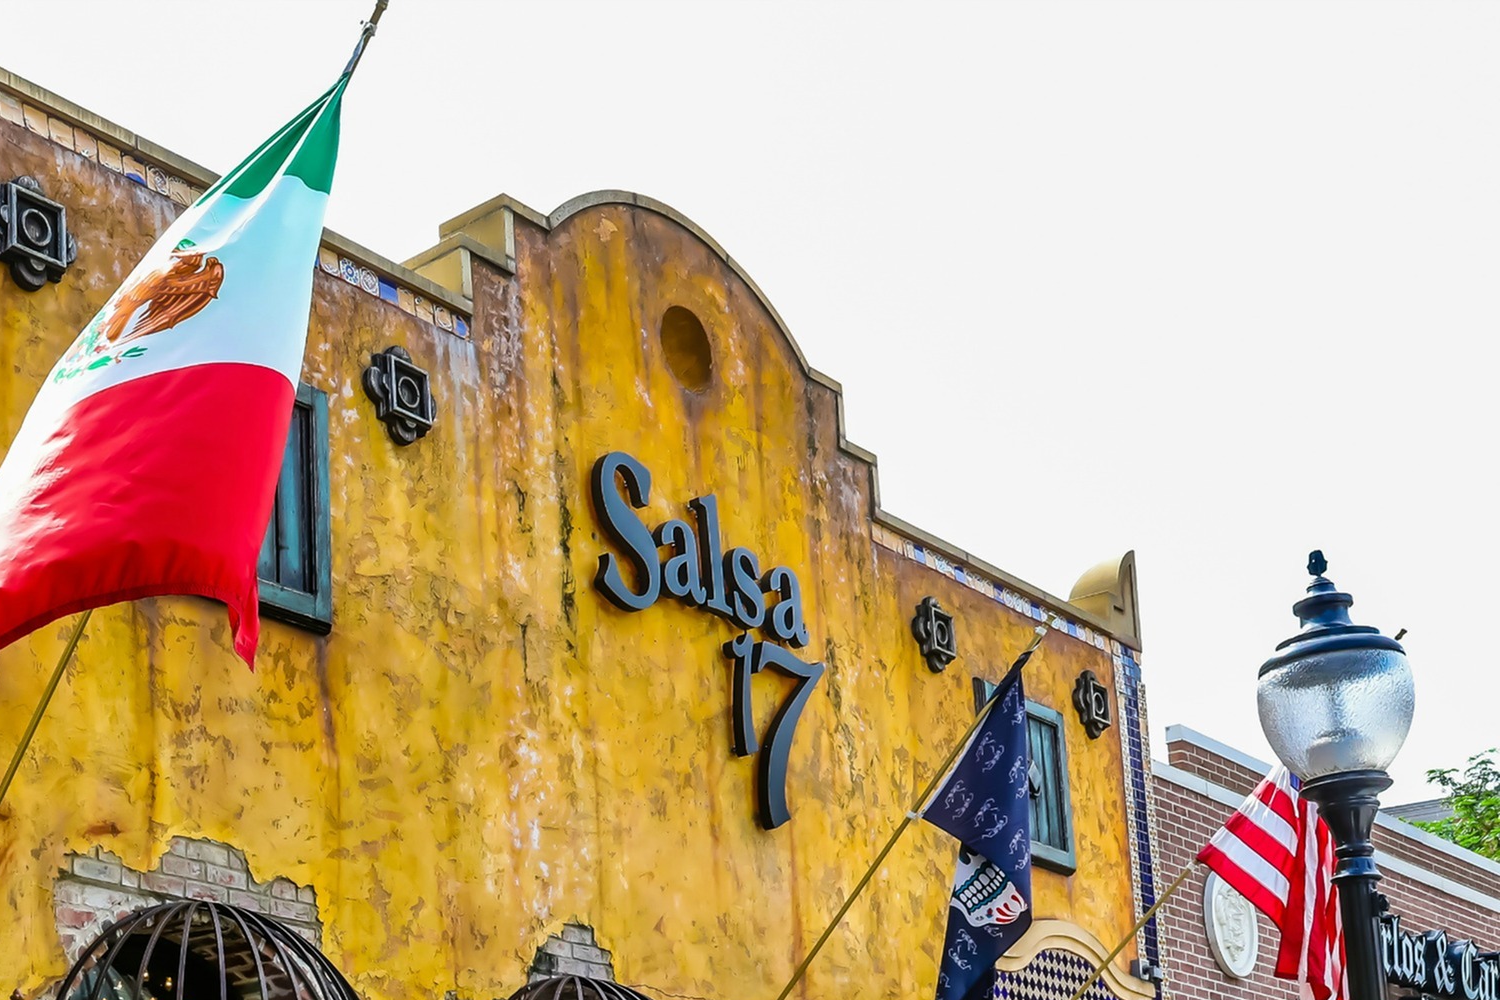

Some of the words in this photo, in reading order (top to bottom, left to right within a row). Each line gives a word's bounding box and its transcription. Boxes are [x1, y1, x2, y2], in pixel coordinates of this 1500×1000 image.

[593, 451, 809, 649] Salsa
[724, 633, 826, 830] 17
[1380, 917, 1427, 987] rlos
[1433, 933, 1455, 995] &
